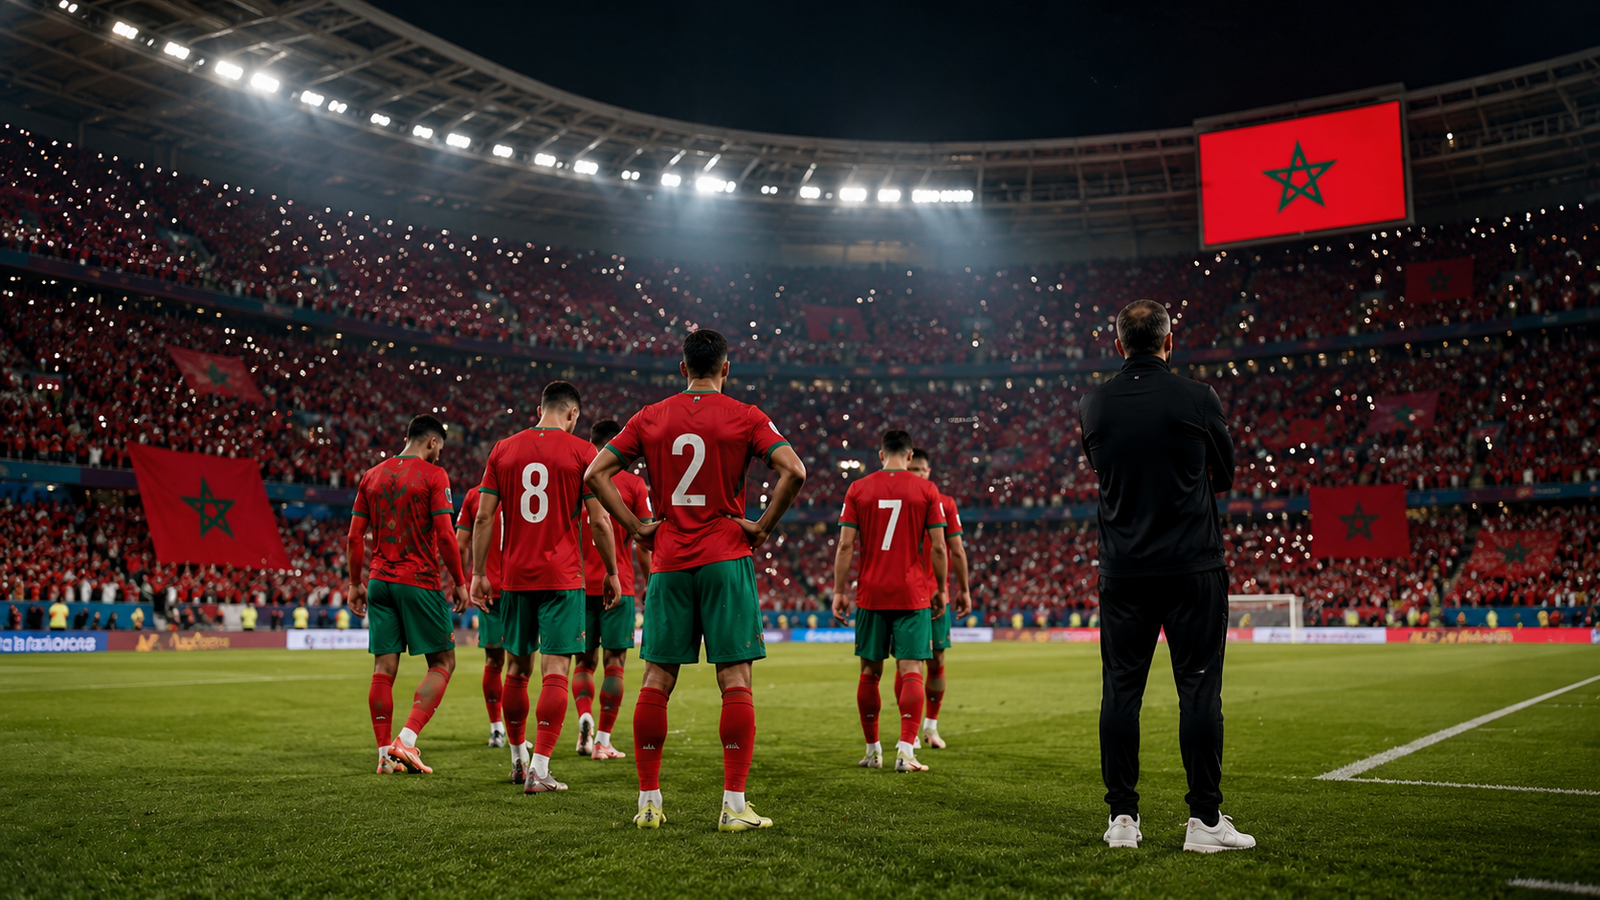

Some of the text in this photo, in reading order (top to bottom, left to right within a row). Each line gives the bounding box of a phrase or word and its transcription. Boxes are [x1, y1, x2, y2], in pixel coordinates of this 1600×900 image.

[520, 463, 549, 523] 8
[672, 434, 706, 506] 2
[878, 500, 902, 550] 7
